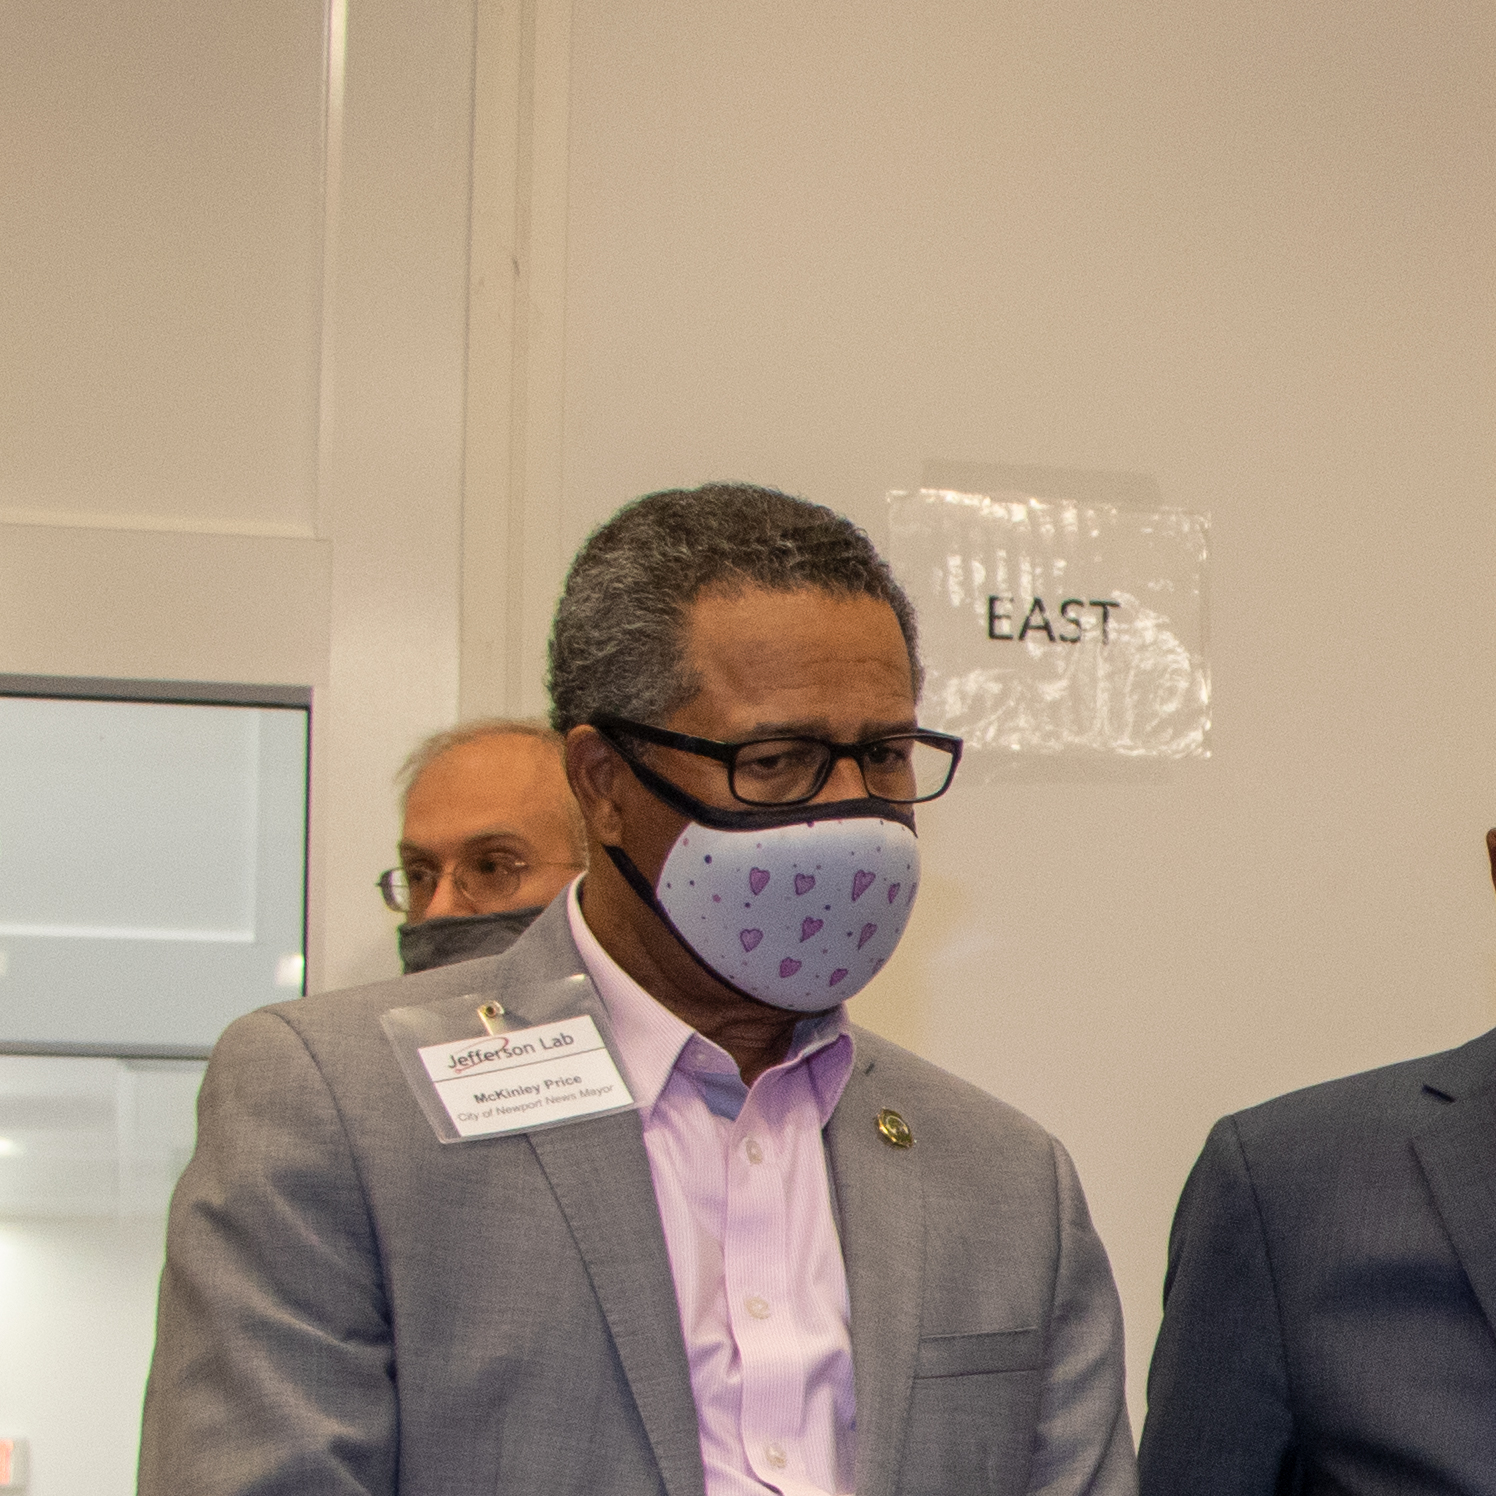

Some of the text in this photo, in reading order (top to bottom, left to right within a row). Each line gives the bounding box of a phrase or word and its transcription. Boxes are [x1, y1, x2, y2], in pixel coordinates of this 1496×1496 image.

[988, 595, 1121, 645] EAST
[448, 1033, 574, 1069] Jefferson Lab
[457, 1084, 614, 1125] City of Newport News Mayor
[474, 1074, 582, 1104] McKinley Price
